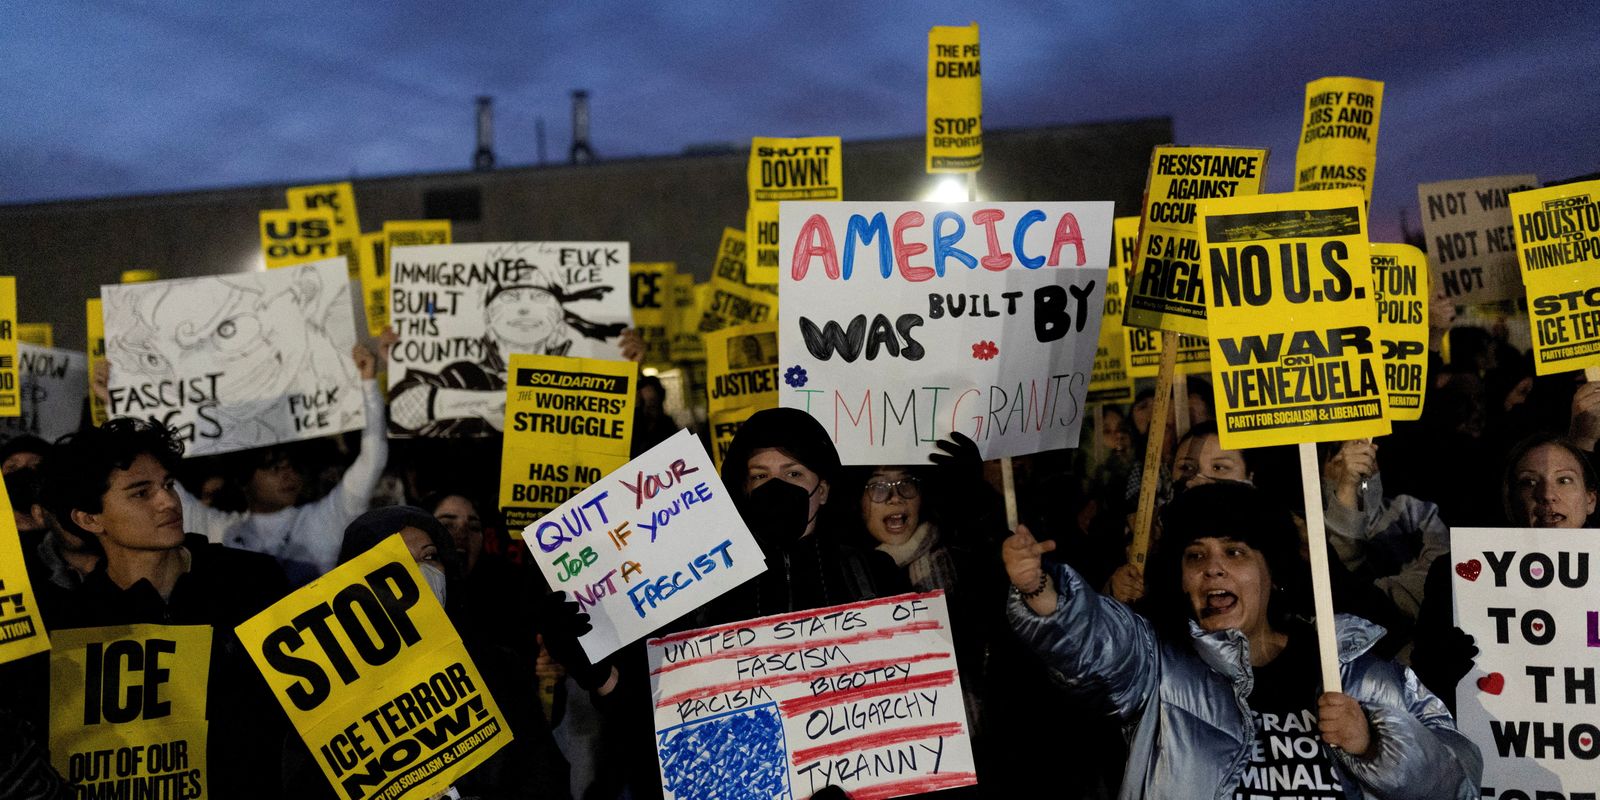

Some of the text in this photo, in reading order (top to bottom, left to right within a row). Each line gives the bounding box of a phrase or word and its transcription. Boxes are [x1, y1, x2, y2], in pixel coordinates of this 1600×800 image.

[936, 44, 959, 58] THE
[1347, 92, 1374, 108] FOR
[934, 118, 977, 135] STOP
[1338, 107, 1373, 126] AND
[757, 145, 833, 157] SHUT IT
[762, 158, 829, 188] DOWN!
[1157, 154, 1258, 178] RESISTANCE
[1320, 165, 1367, 182] MASS
[1167, 179, 1239, 200] AGAINST
[1544, 195, 1589, 211] FROM
[1427, 192, 1466, 221] NOT
[266, 220, 330, 239] US
[1562, 232, 1584, 243] TO
[267, 242, 332, 258] OUT
[559, 248, 619, 267] FUCK
[791, 209, 1086, 282] AMERICA
[1147, 234, 1163, 256] IS
[1164, 237, 1175, 258] A
[1436, 230, 1477, 264] NOT
[394, 259, 526, 287] IMMIGRANTS
[566, 268, 603, 285] ICE
[1209, 240, 1366, 307] NO U.S.
[1442, 267, 1484, 298] NOT
[392, 290, 462, 315] BUILT
[1164, 303, 1192, 313] Socialism
[1192, 308, 1204, 317] and
[394, 318, 439, 336] THIS
[799, 280, 1095, 363] WAS BUILT BY
[1536, 316, 1570, 346] ICE
[391, 337, 487, 362] COUNTRY
[1129, 329, 1156, 351] ICE
[1217, 326, 1374, 366] WAR
[1284, 355, 1309, 366] ON
[1541, 349, 1561, 361] PARTY
[109, 372, 224, 414] FASCIST
[531, 373, 615, 390] SOLIDARITY!
[712, 369, 772, 399] JUSTICE
[1221, 358, 1380, 409] VENEZUELA
[288, 386, 339, 414] FUCK
[517, 391, 533, 402] THE
[795, 372, 1085, 447] IMMIGRANTS
[295, 413, 331, 432] ICE
[513, 412, 624, 439] STRUGGLE
[1228, 403, 1379, 429] PARTY FOR SOCIALISM & LIBERATION
[528, 463, 601, 484] HAS NO
[535, 458, 699, 553] QUIT YOUR
[552, 482, 713, 582] JOB IF YOU'RE
[627, 539, 733, 618] FASCIST
[1482, 551, 1589, 588] YOU
[573, 560, 642, 613] NOT A
[262, 561, 422, 711] STOP
[664, 601, 928, 663] UNITED STATES OF
[1487, 607, 1556, 646] TO
[737, 646, 850, 679] FASCISM
[84, 638, 176, 726] ICE
[677, 663, 911, 724] RACISM BIGOTRY
[320, 662, 477, 778] ICE TERROR
[805, 690, 938, 740] OLIGARCHY
[341, 694, 489, 800] NOW!
[399, 760, 445, 789] SOCIALISM
[442, 751, 455, 765] &
[452, 722, 498, 758] LIBERATION
[70, 740, 188, 783] OUT OF OUR
[797, 736, 943, 794] TYRANNY
